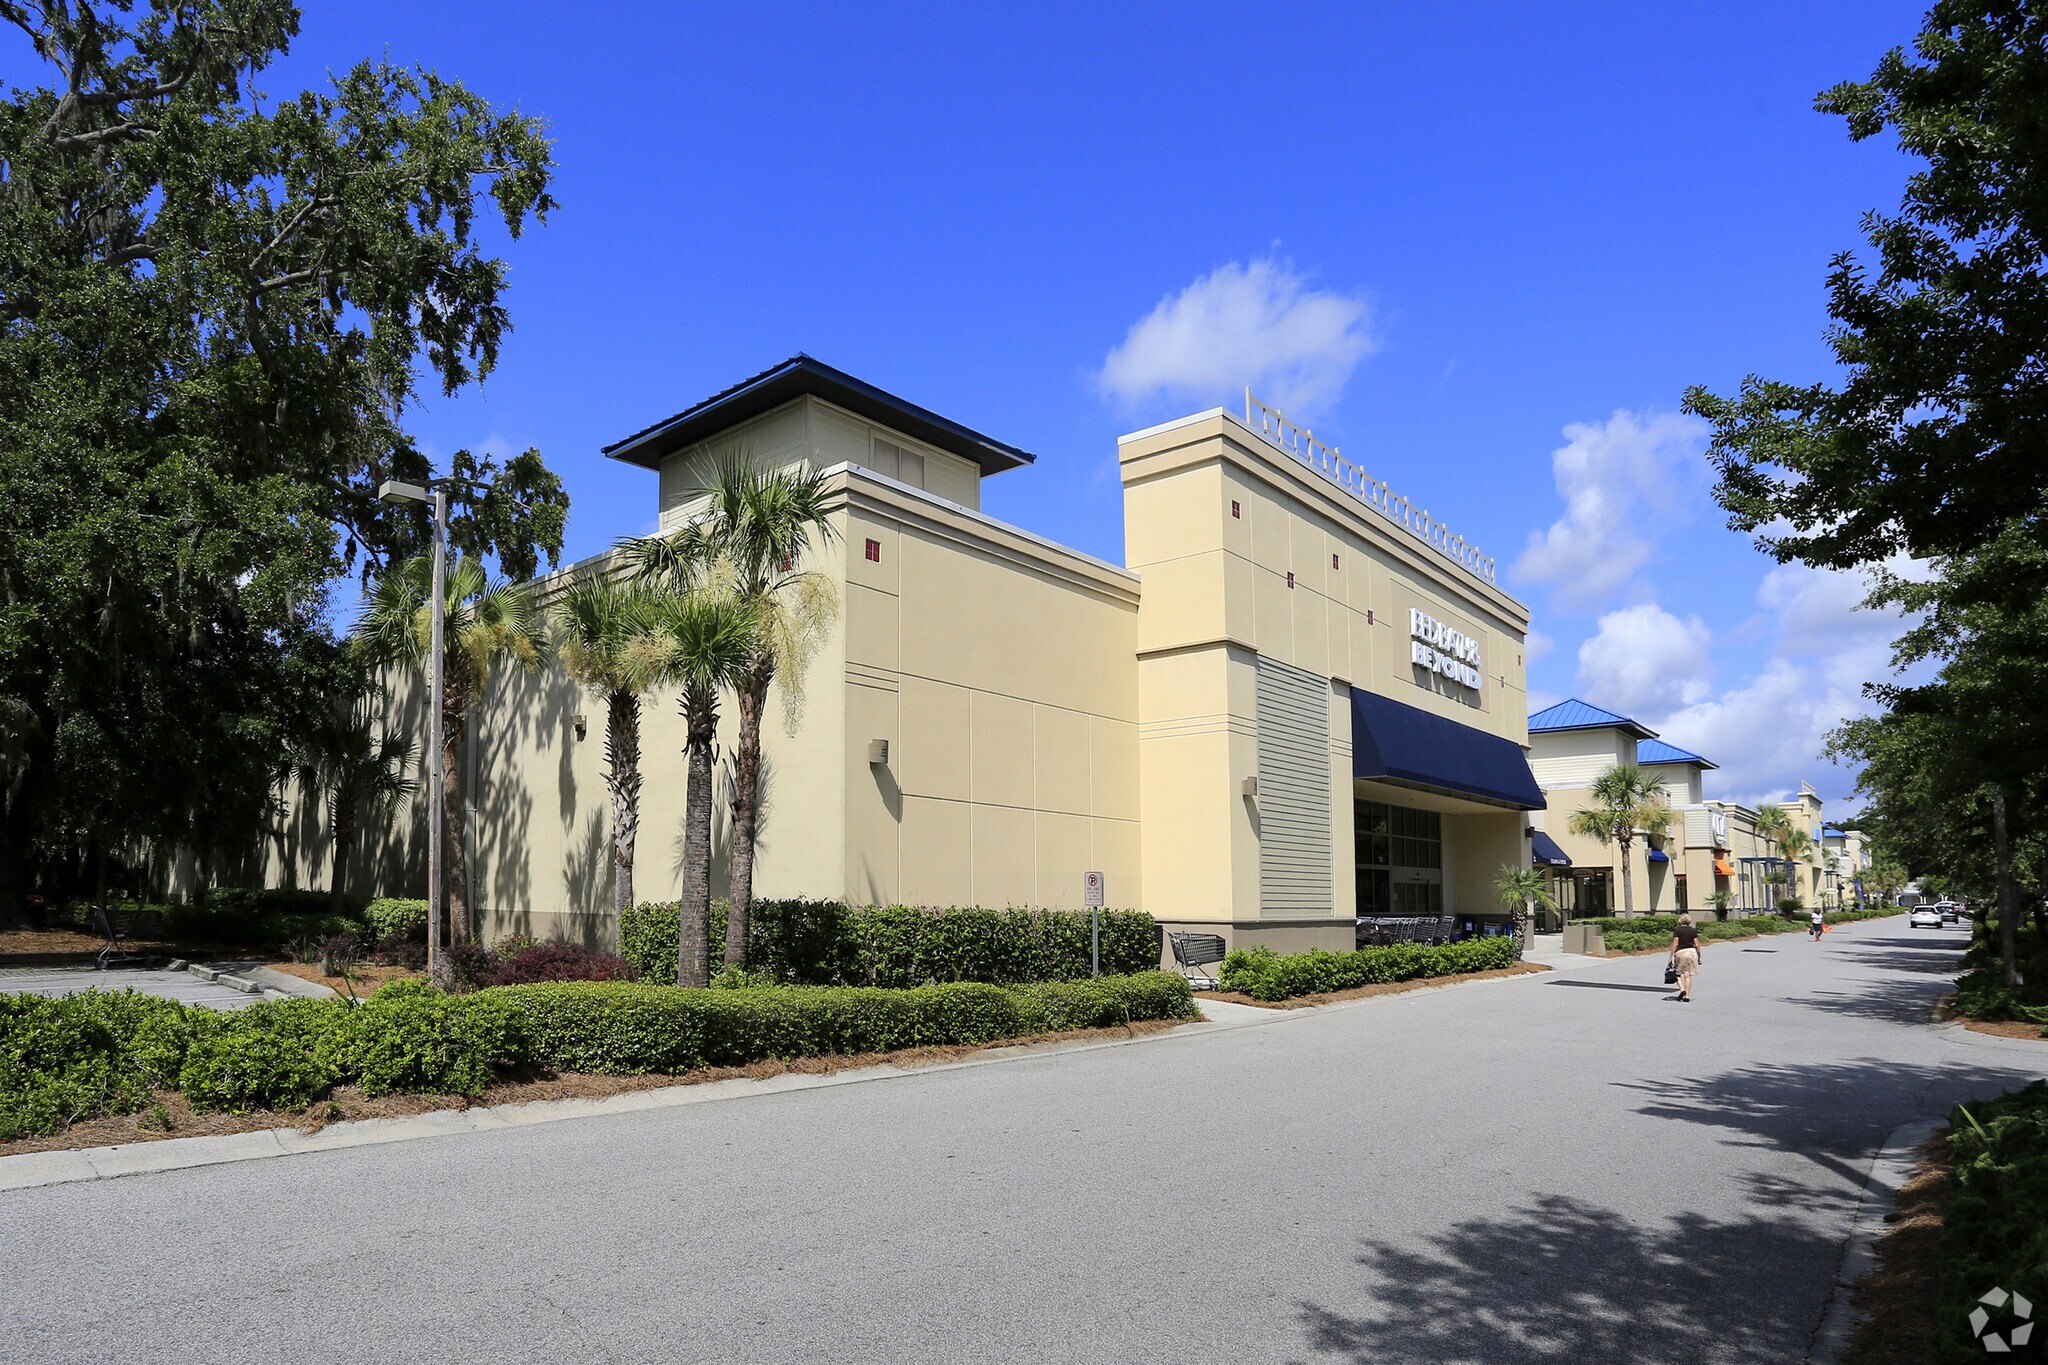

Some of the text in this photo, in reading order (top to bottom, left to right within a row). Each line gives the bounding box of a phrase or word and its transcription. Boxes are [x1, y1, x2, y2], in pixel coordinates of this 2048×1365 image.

[1409, 608, 1481, 666] BED BATH &
[1411, 641, 1482, 689] BEYOND
